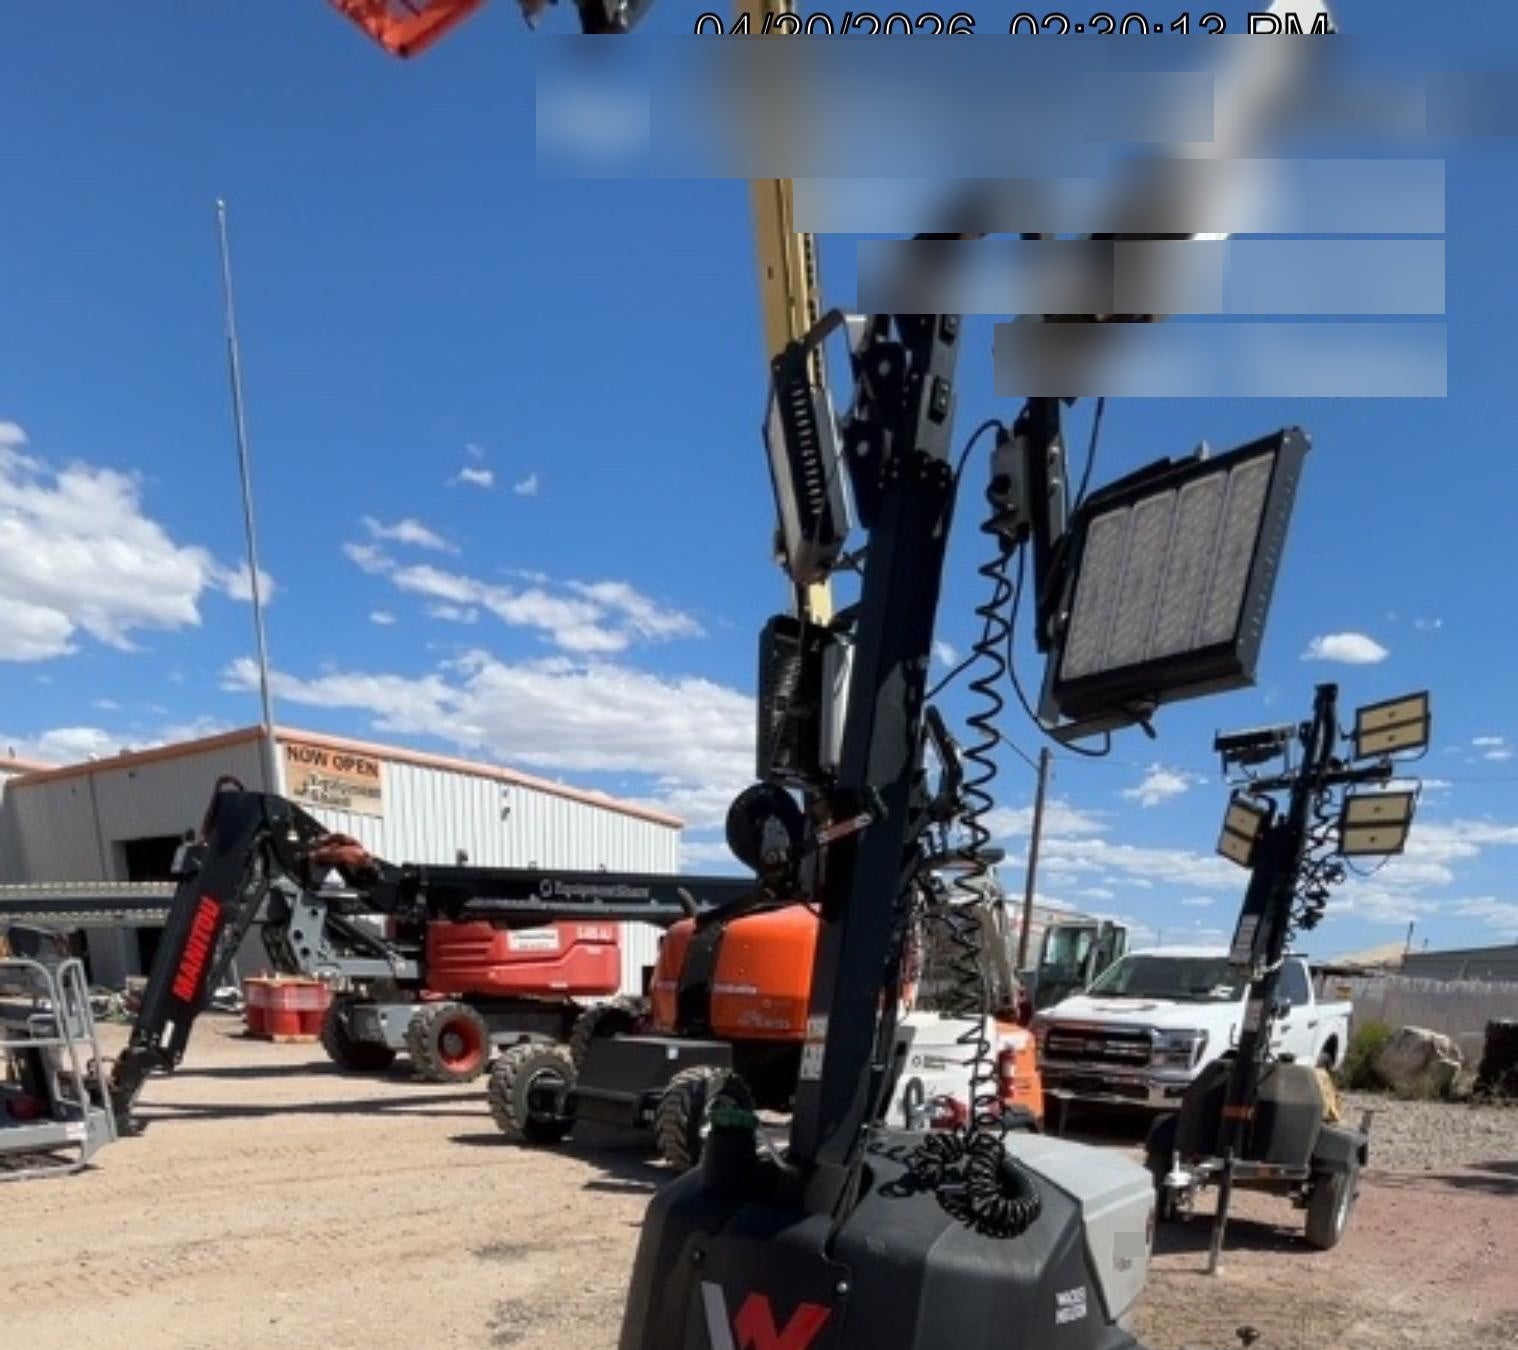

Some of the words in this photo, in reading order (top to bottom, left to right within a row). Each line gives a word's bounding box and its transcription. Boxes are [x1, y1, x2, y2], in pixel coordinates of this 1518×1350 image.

[287, 745, 328, 766] NOW
[332, 755, 379, 778] OPEN
[172, 896, 220, 1002] MANITOU
